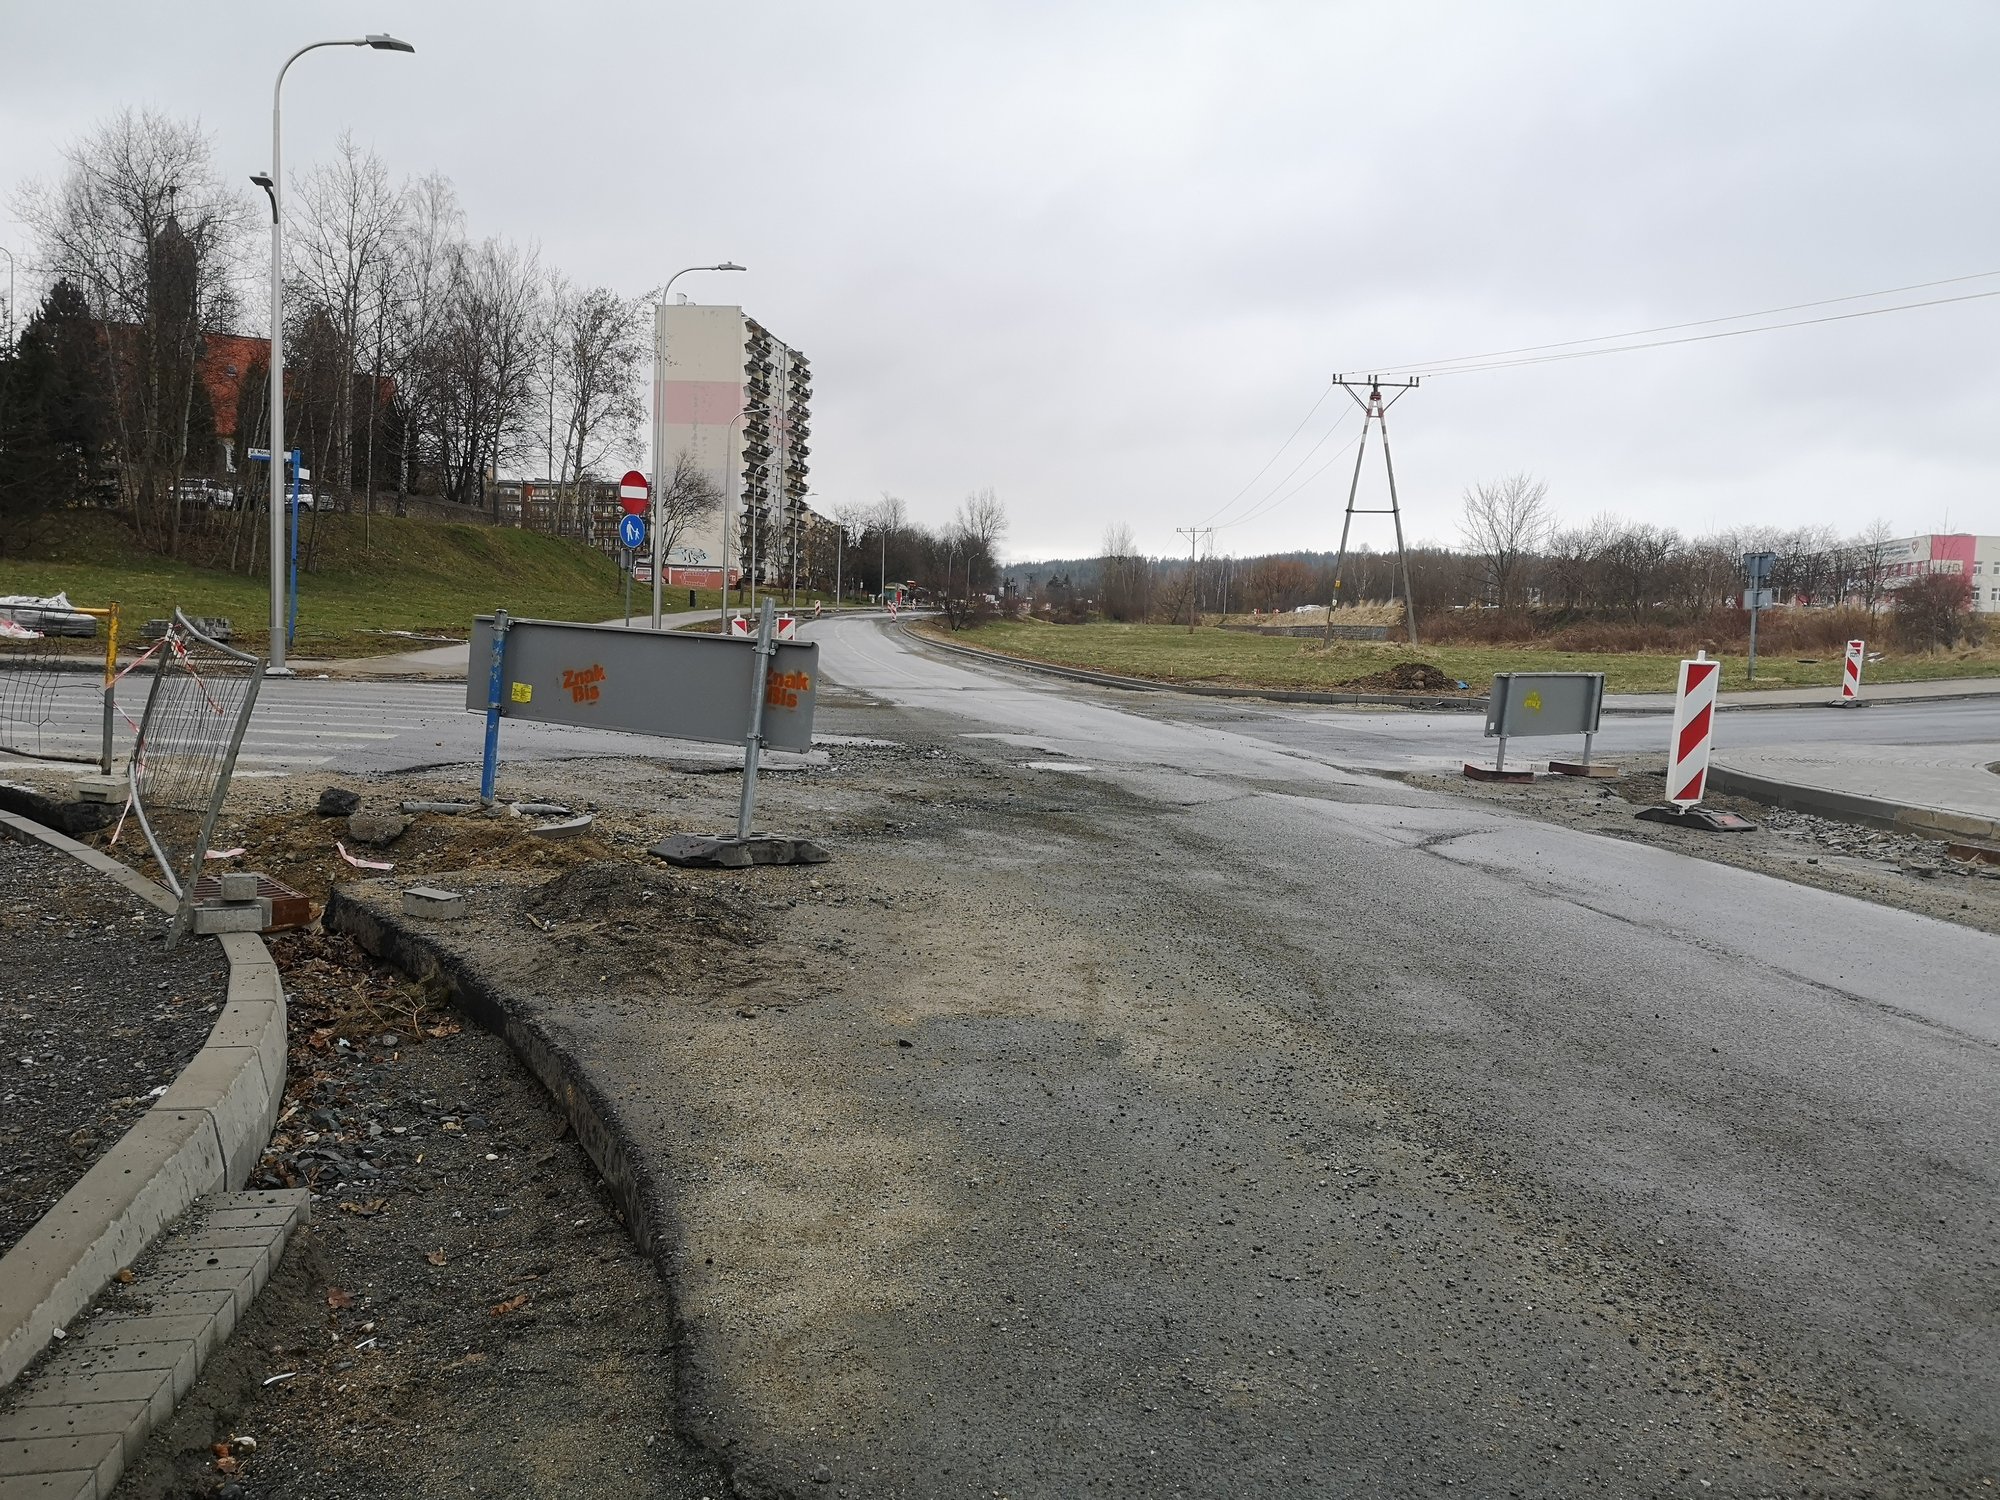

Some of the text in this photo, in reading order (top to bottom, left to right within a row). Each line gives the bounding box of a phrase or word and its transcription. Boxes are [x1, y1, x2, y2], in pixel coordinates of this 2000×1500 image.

[562, 664, 606, 688] Znak
[573, 685, 599, 703] Bis
[766, 686, 798, 708] Bis
